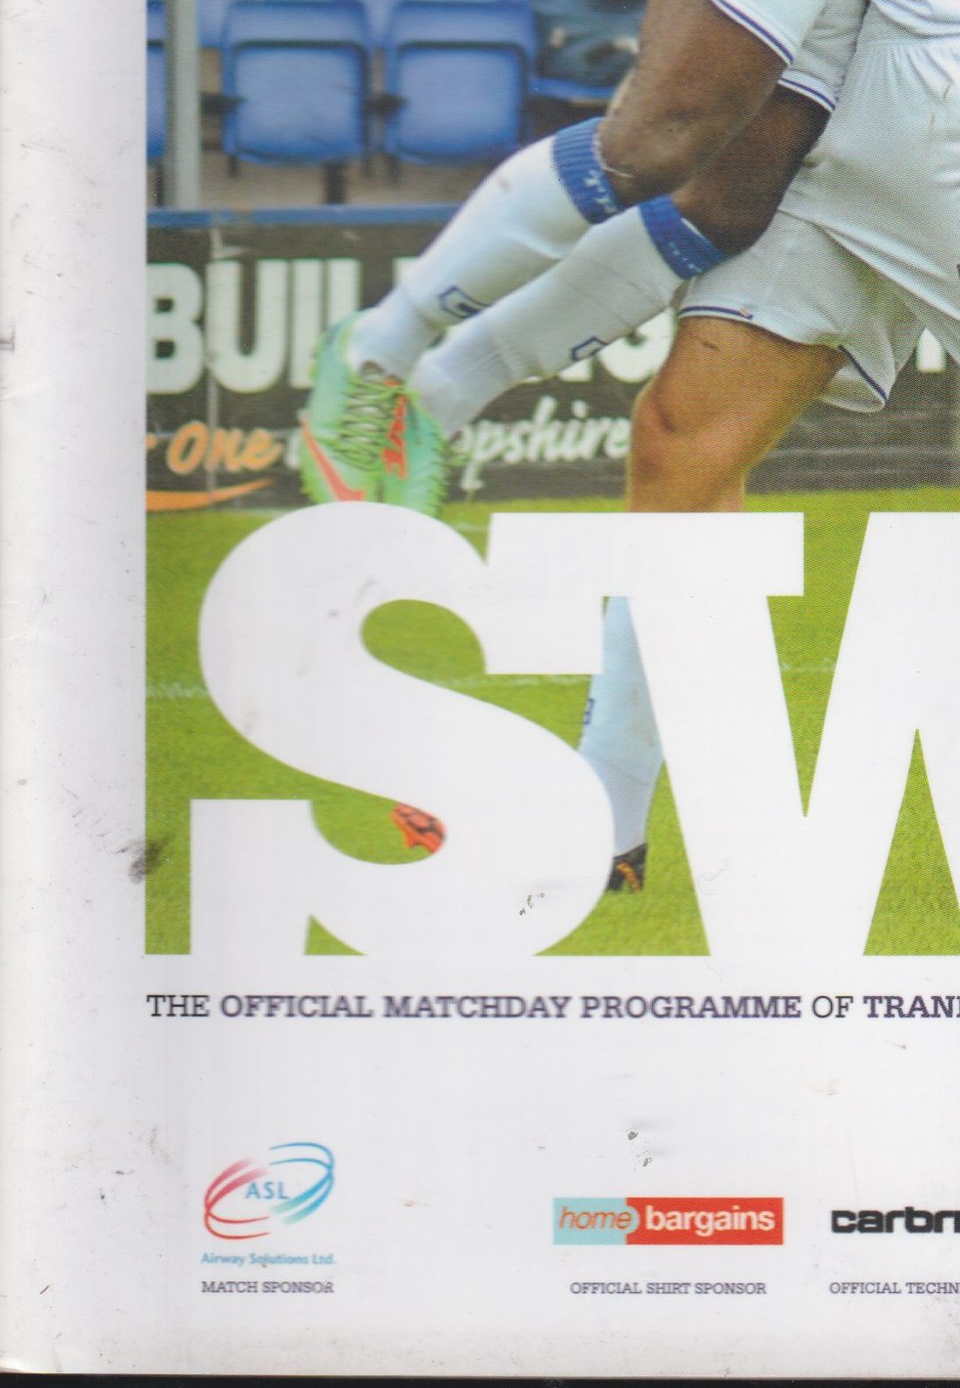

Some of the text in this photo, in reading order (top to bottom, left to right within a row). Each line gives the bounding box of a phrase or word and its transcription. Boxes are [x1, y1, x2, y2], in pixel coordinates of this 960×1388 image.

[166, 420, 284, 475] One
[146, 994, 210, 1018] THE
[220, 994, 373, 1018] OFFICIAL
[382, 994, 572, 1018] MATCHDAY
[581, 994, 802, 1018] PROGRAMME
[812, 994, 854, 1018] OF
[244, 1181, 290, 1200] ASL
[559, 1204, 775, 1236] home bargains
[201, 1253, 245, 1267] Airway
[201, 1281, 334, 1294] MATCH SPONSOR
[570, 1282, 767, 1295] OFFICIAL SHIRT SPONSOR
[829, 1282, 902, 1295] OFFICIAL
